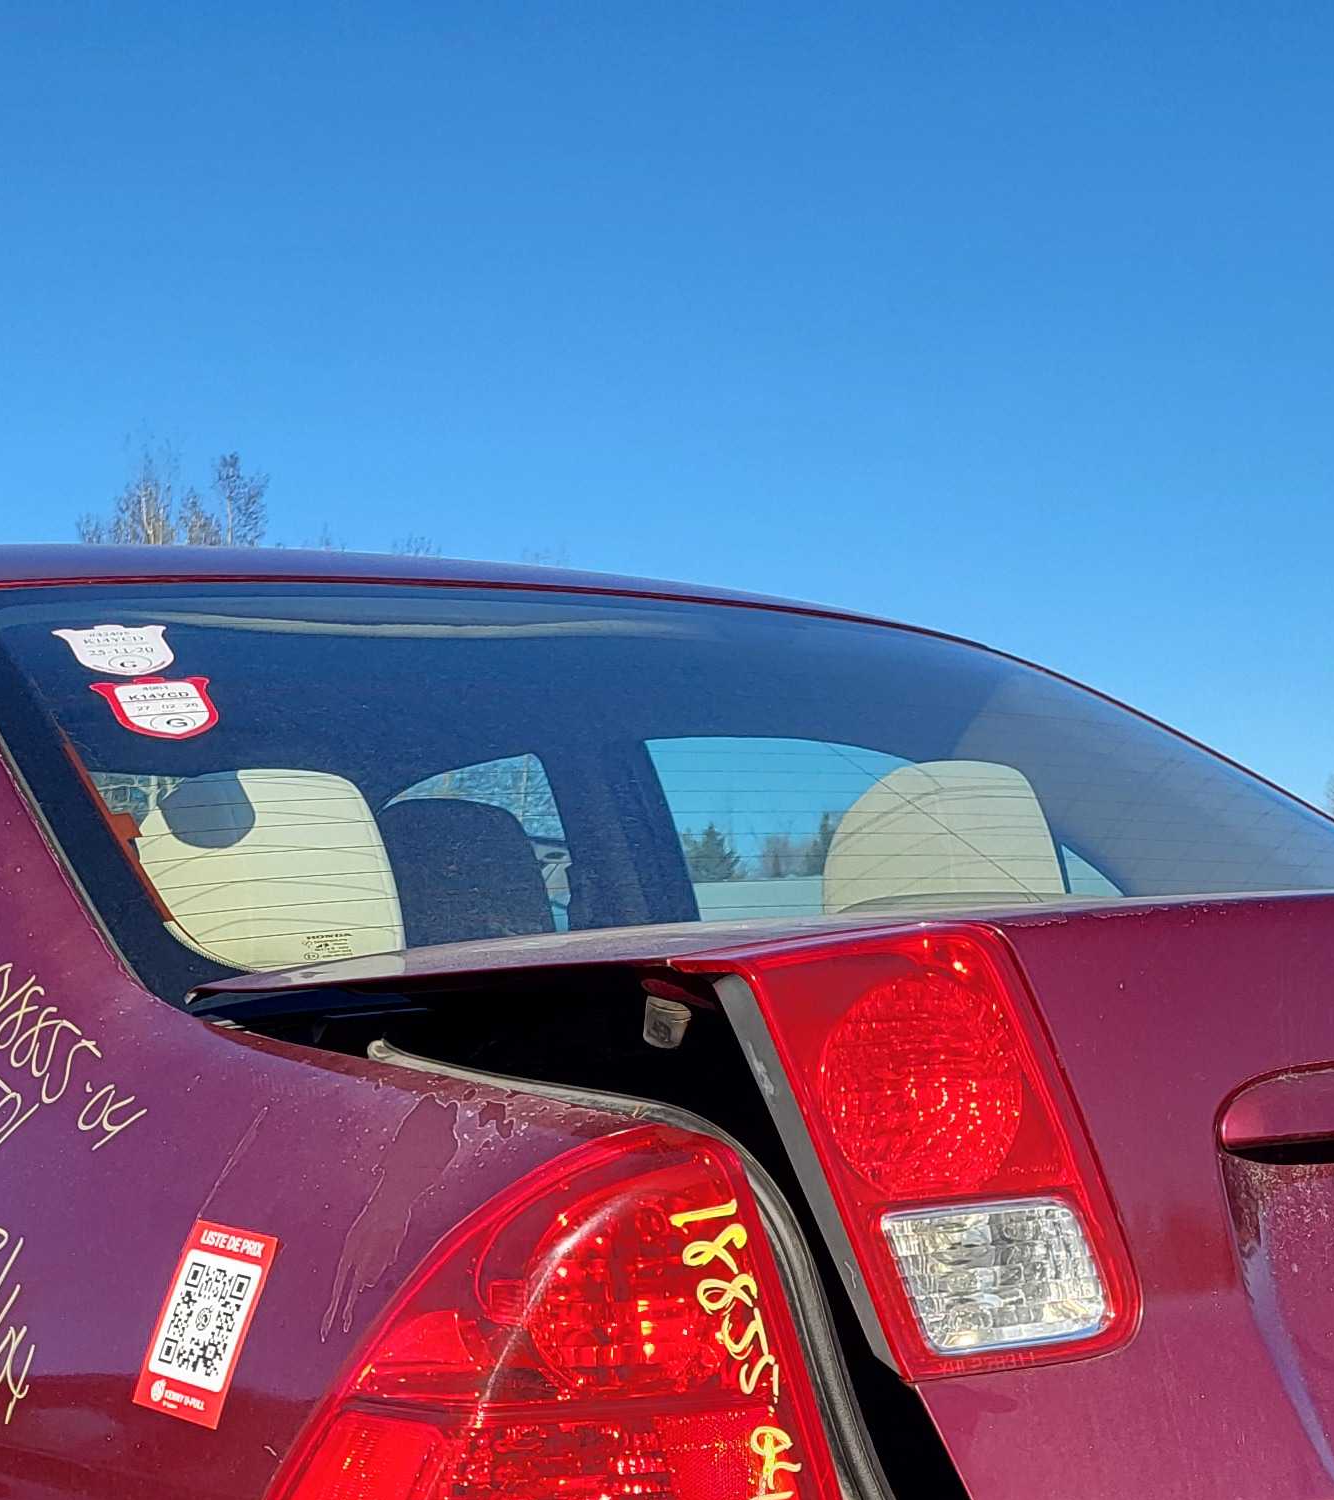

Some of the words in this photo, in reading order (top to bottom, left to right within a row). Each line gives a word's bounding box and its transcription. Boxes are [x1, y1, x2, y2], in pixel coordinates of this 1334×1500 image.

[128, 691, 190, 701] K14YCD
[166, 718, 188, 728] G
[200, 1228, 229, 1250] LISTE
[226, 1235, 244, 1253] DE
[239, 1238, 266, 1259] PRIX
